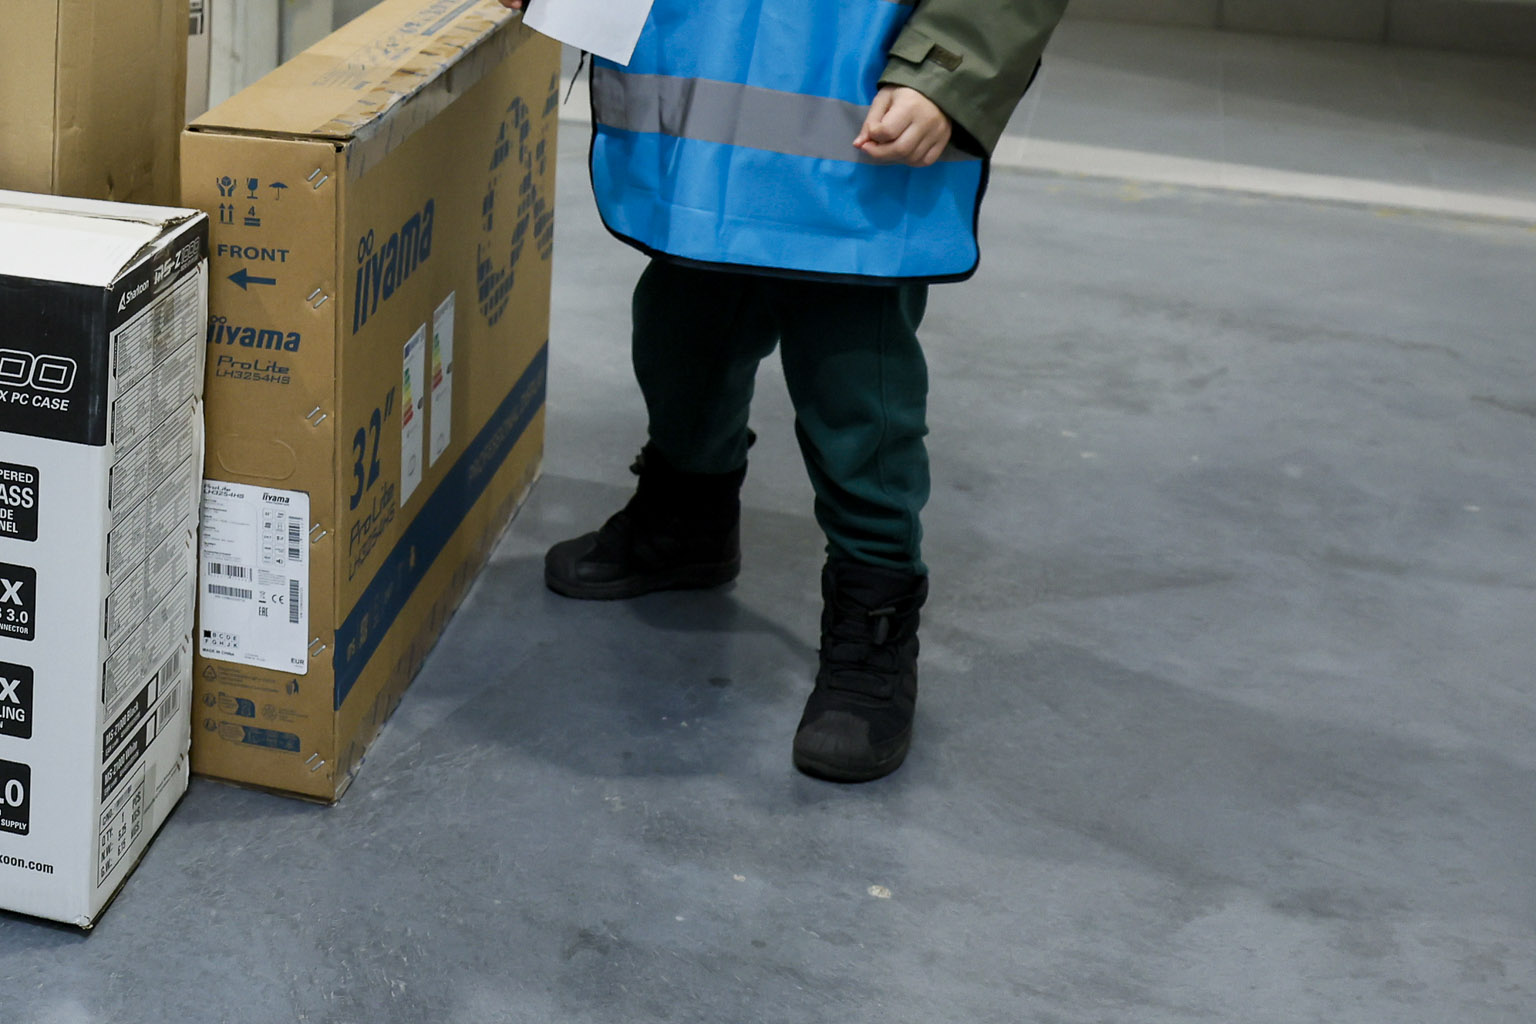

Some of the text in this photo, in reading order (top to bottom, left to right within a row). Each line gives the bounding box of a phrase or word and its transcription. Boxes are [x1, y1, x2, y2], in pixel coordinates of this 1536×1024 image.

[217, 244, 289, 262] FRONT
[353, 198, 435, 336] iiyama
[126, 280, 149, 304] Sharkoon
[217, 355, 290, 374] ProLite
[10, 391, 29, 406] PC
[32, 394, 70, 411] CASE
[6, 608, 29, 624] 3.0
[1, 818, 27, 830] SUPPLY
